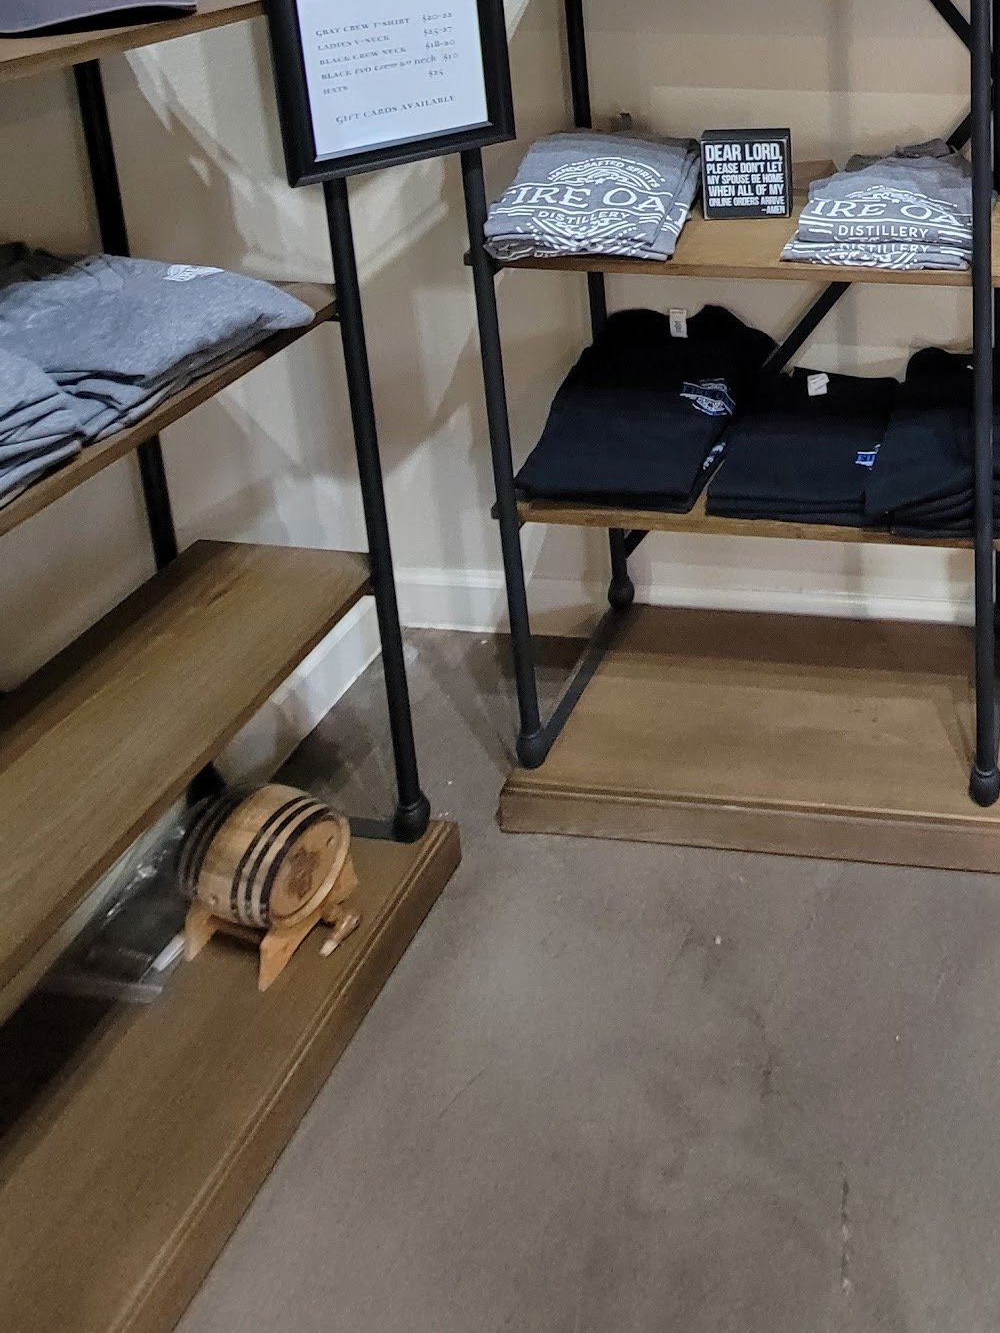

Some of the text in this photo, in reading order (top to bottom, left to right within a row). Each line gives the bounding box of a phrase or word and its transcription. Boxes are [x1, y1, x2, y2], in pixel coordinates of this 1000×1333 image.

[315, 27, 341, 37] GRAY
[343, 23, 369, 32] CREW
[372, 17, 411, 28] T-SHIRT
[317, 41, 352, 51] LADIES
[353, 34, 391, 45] V-NECK
[319, 56, 350, 66] BLACK
[352, 50, 379, 60] CREW
[381, 46, 407, 56] NECK
[321, 70, 352, 80] BLACK
[443, 53, 458, 63] $10
[323, 85, 349, 95] HATS
[335, 95, 456, 125] GIFT CARDS AVAILABLE
[704, 143, 783, 162] DEAR LORD,
[547, 158, 661, 189] HANDCRAFTED SPIRITS
[706, 161, 783, 174] PLEASE DON'T LET
[707, 173, 784, 185] MY SPOUSE BE HOME
[708, 184, 784, 197] WHEN ALL OF MY
[708, 196, 785, 207] ONLINE ORDERS ARRIVE
[536, 211, 631, 226] DISTILLERY
[810, 200, 887, 217] IRE
[900, 203, 964, 227] OA
[838, 225, 929, 239] DISTILLERY
